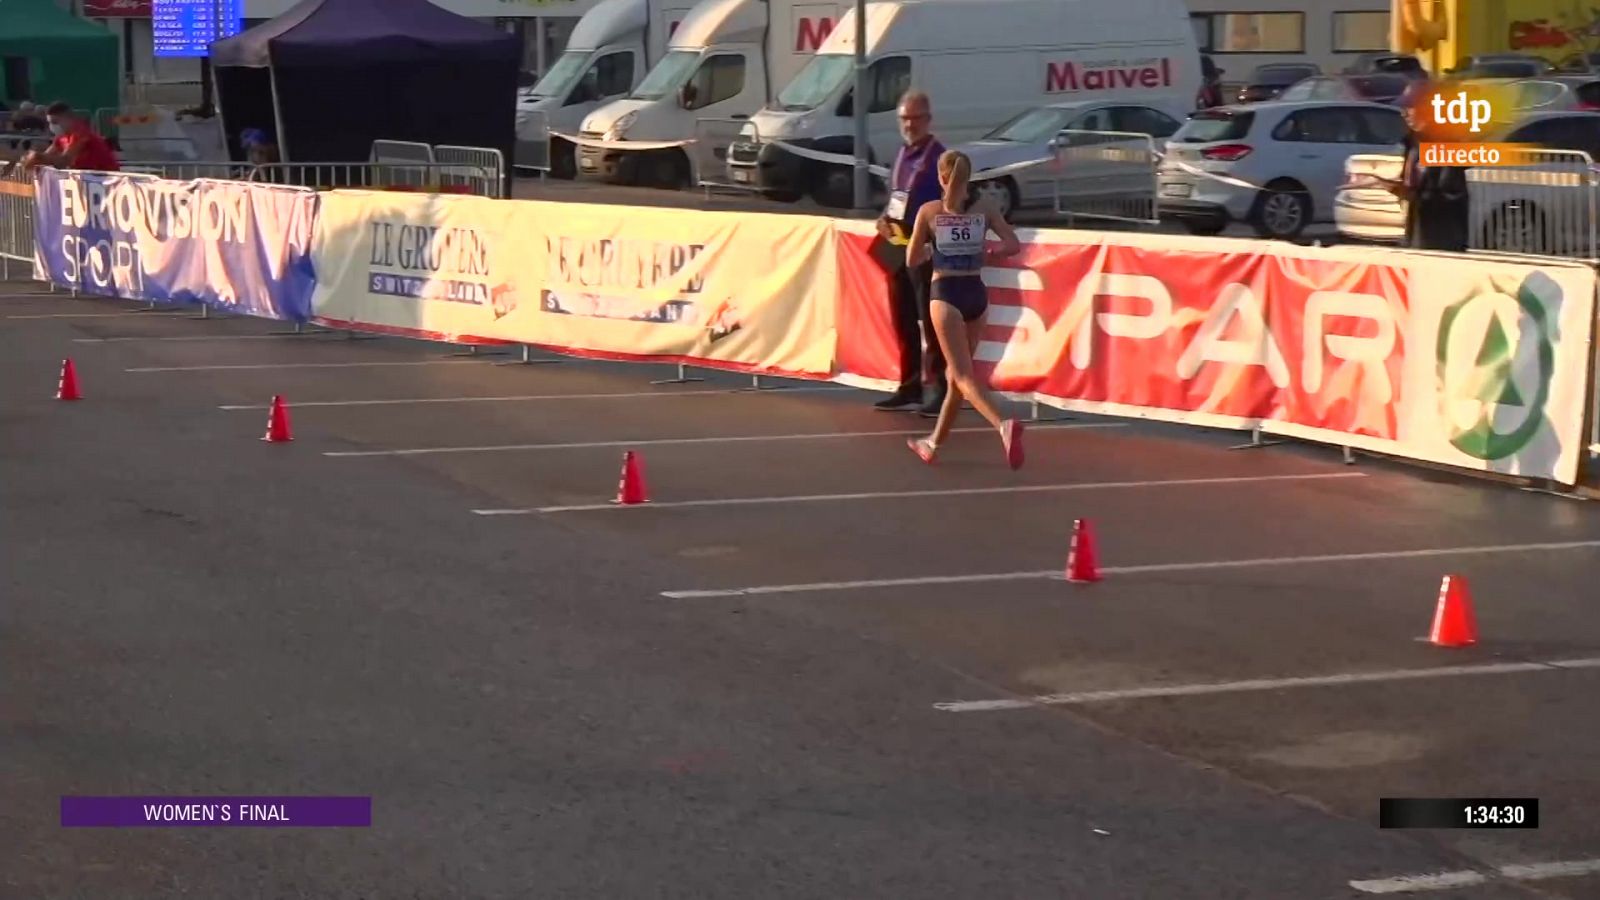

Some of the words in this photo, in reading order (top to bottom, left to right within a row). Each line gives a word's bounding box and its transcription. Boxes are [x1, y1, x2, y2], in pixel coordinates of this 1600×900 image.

[1046, 57, 1171, 91] Maivel
[60, 176, 247, 244] EUROVISION
[951, 227, 971, 241] 56
[62, 234, 144, 292] SPORT
[369, 221, 394, 267] LE
[543, 235, 571, 284] E
[577, 238, 704, 294] GRYERE
[372, 276, 487, 303] SITZLAND
[973, 265, 1395, 412] SPAR
